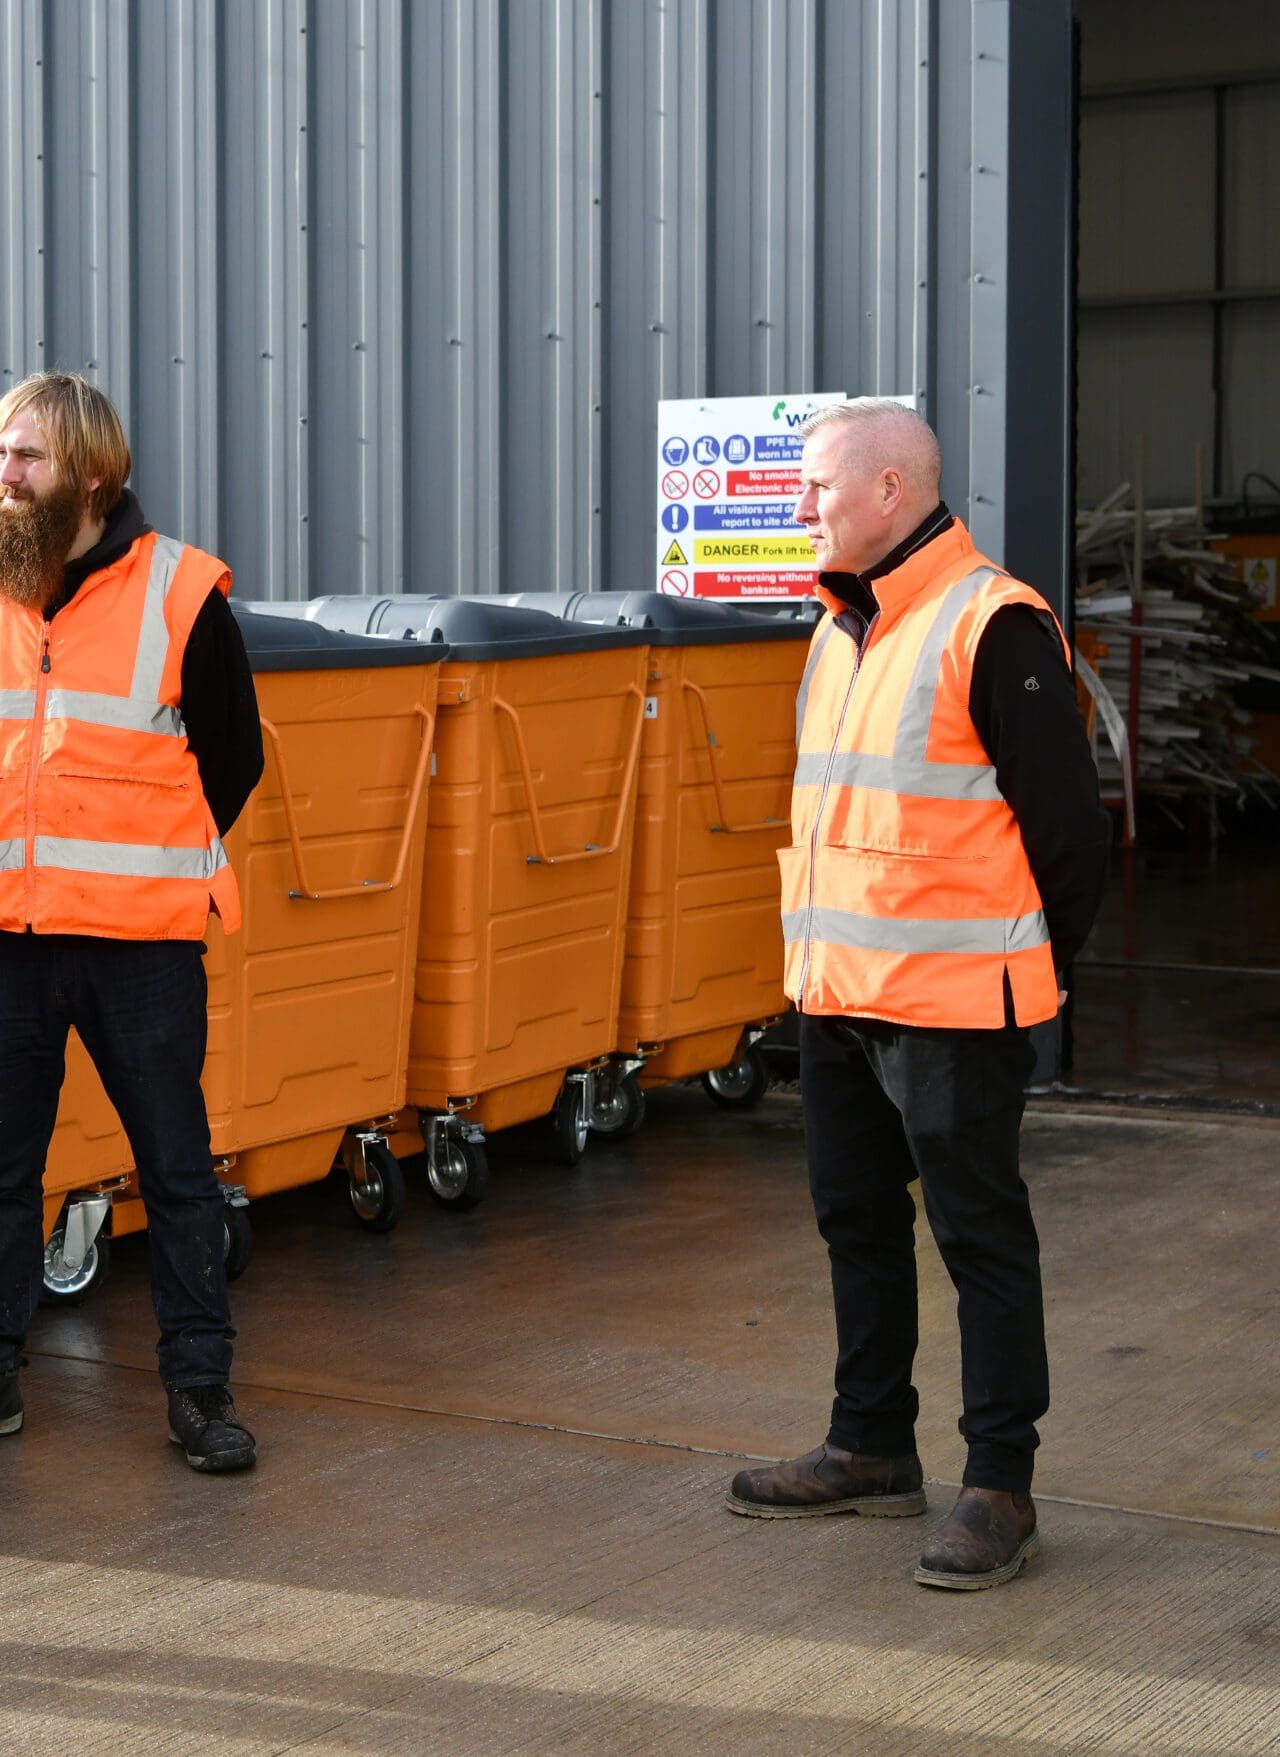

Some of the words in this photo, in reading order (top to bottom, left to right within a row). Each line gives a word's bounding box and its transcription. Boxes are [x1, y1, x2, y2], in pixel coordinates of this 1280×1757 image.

[766, 437, 785, 447] PPE
[787, 436, 806, 447] Mus
[757, 450, 781, 460] worn
[782, 449, 791, 459] in
[792, 448, 802, 459] th
[748, 472, 763, 481] No
[735, 483, 783, 494] Electronic
[713, 506, 726, 515] All
[727, 504, 763, 515] visitors
[764, 504, 783, 514] and
[721, 518, 750, 529] report
[751, 518, 761, 527] to
[763, 516, 781, 527] site
[703, 544, 759, 557] DANGER
[763, 546, 783, 556] Fork
[785, 546, 797, 555] lift
[717, 573, 730, 583] No
[732, 572, 777, 585] reversing
[778, 572, 814, 583] without
[741, 585, 789, 595] banksman
